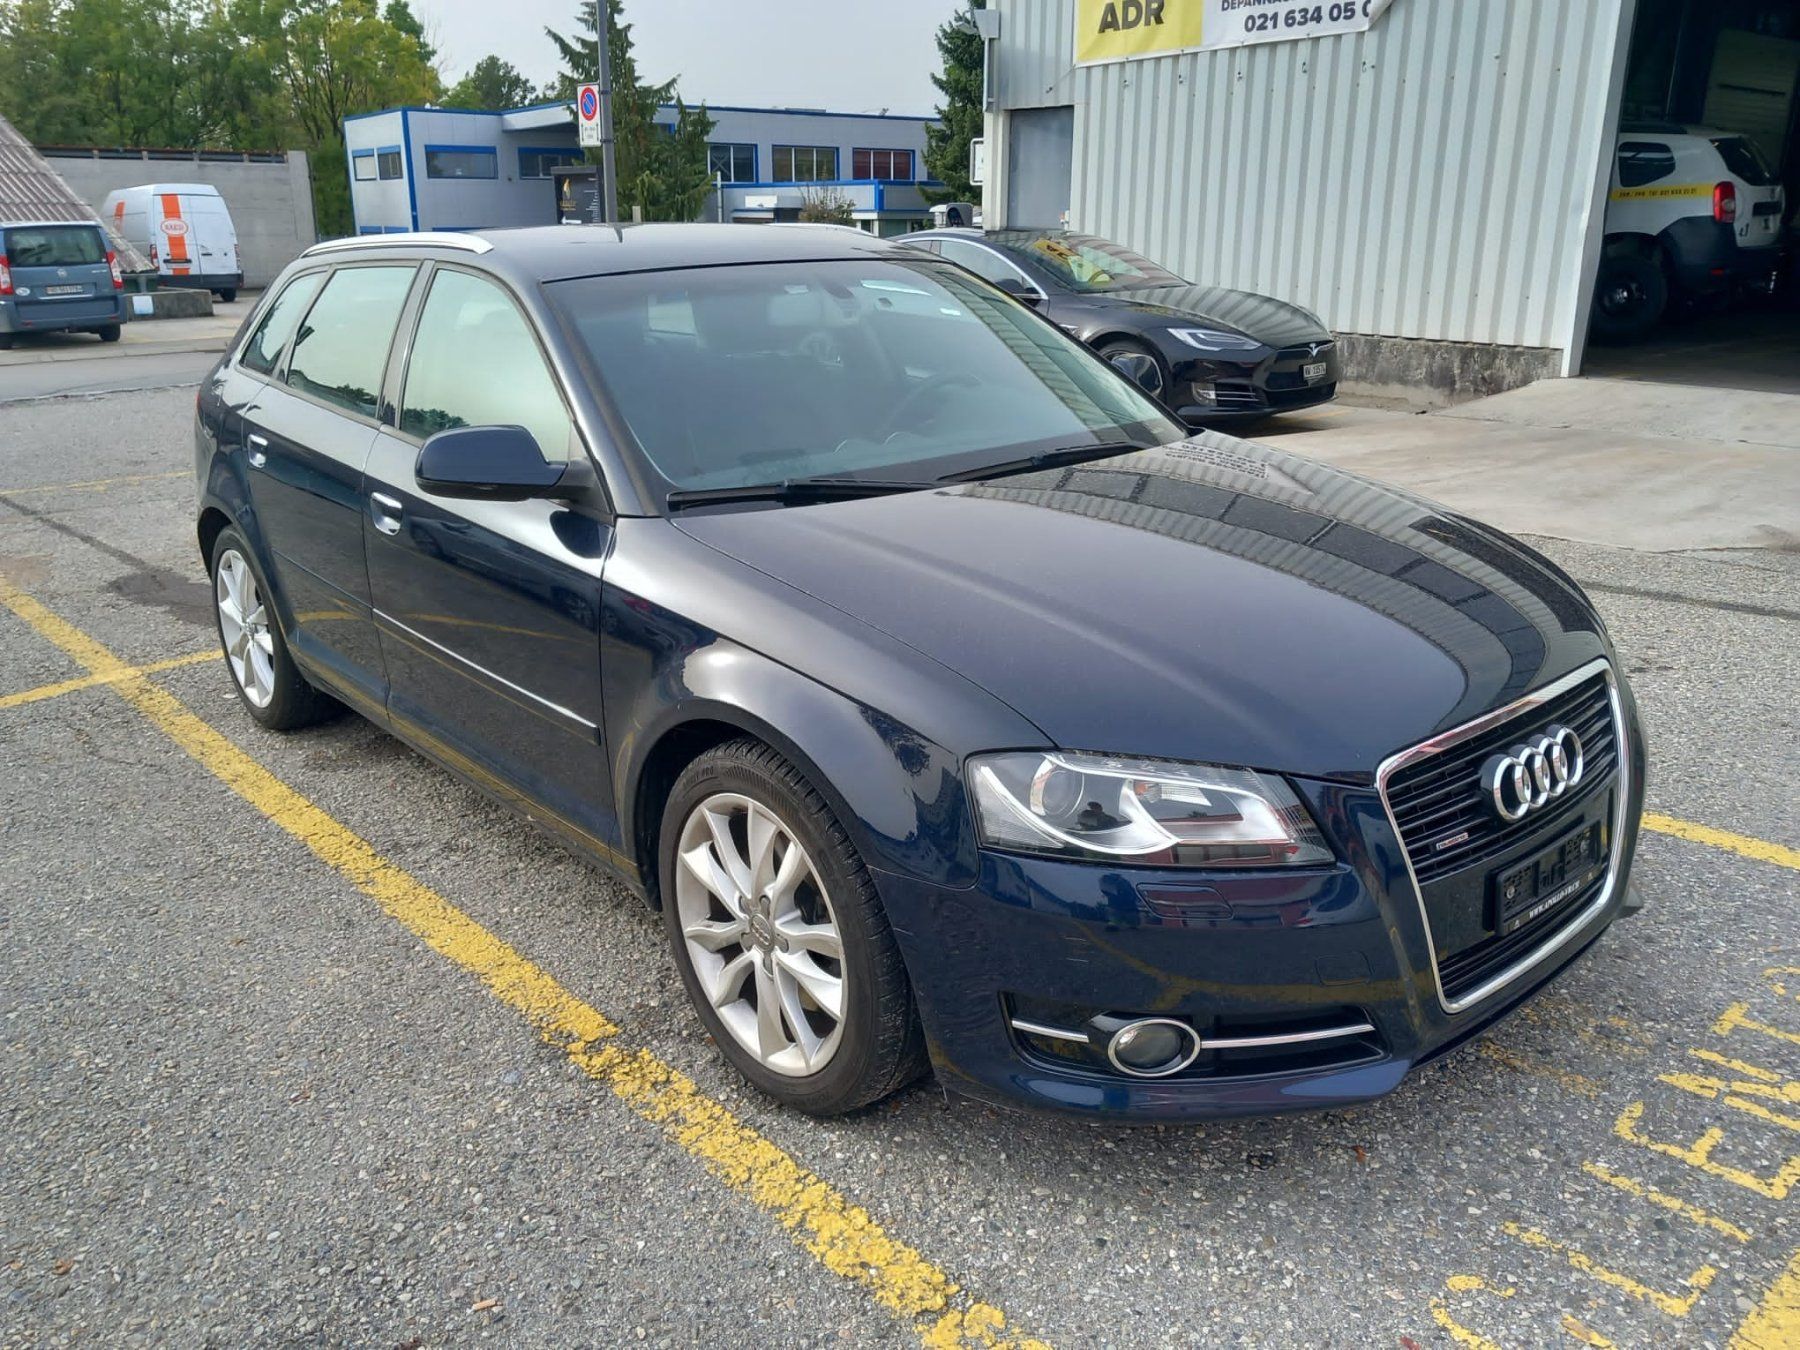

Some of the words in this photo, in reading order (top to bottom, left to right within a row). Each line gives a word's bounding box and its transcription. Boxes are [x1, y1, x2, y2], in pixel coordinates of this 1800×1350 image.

[1098, 0, 1163, 33] ADR
[1244, 12, 1279, 32] 021
[1284, 6, 1323, 27] 634
[1329, 2, 1356, 21] 05
